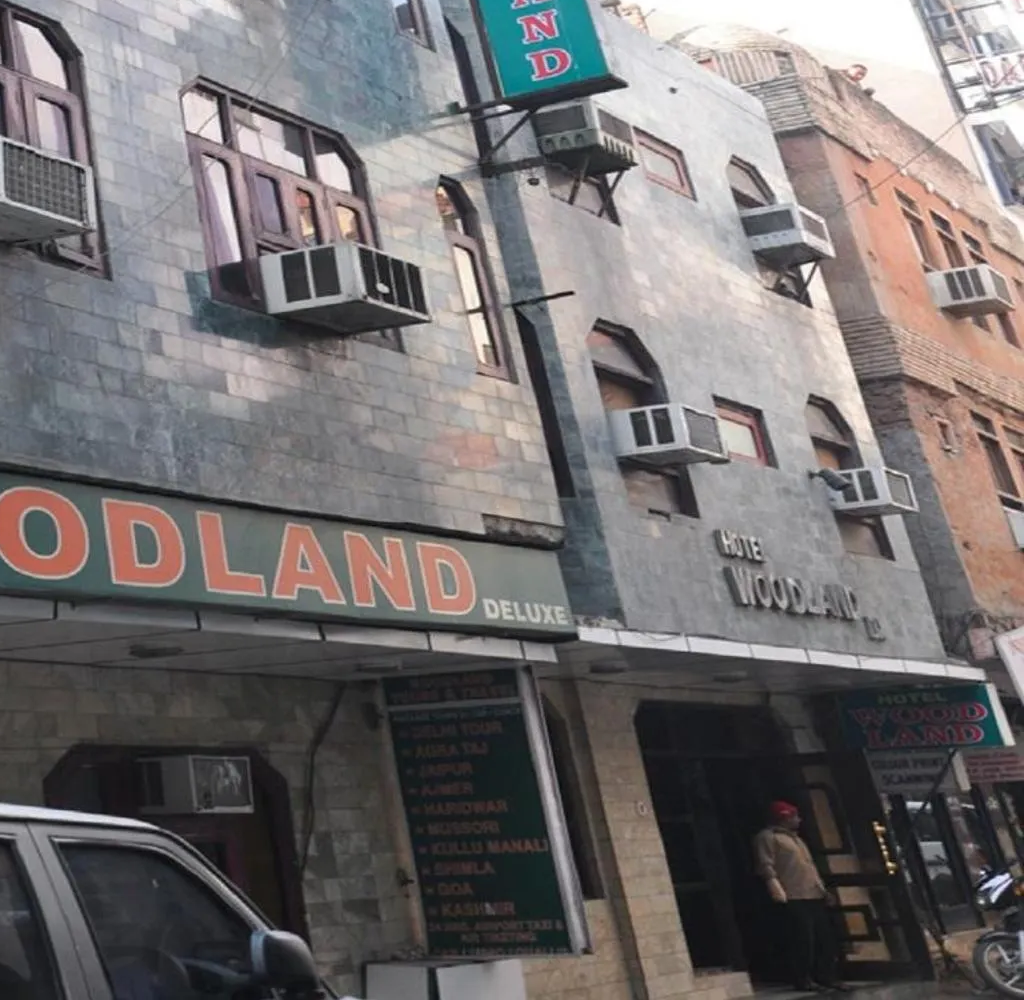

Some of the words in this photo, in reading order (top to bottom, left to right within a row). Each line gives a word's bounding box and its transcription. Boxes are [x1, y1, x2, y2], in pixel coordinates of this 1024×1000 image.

[723, 566, 861, 620] WOODLAND
[483, 598, 570, 626] DELUXE
[876, 692, 948, 705] HOTEL
[848, 702, 988, 727] WOOD
[411, 723, 457, 739] DELHI
[460, 721, 504, 736] TOUR
[863, 723, 985, 749] LAND
[419, 762, 475, 778] JAIPUR
[424, 799, 508, 815] HARIDWAR
[431, 841, 484, 855] KULLU
[487, 838, 549, 853] MANALI
[433, 860, 495, 875] SHIMLA
[437, 882, 475, 896] GOA
